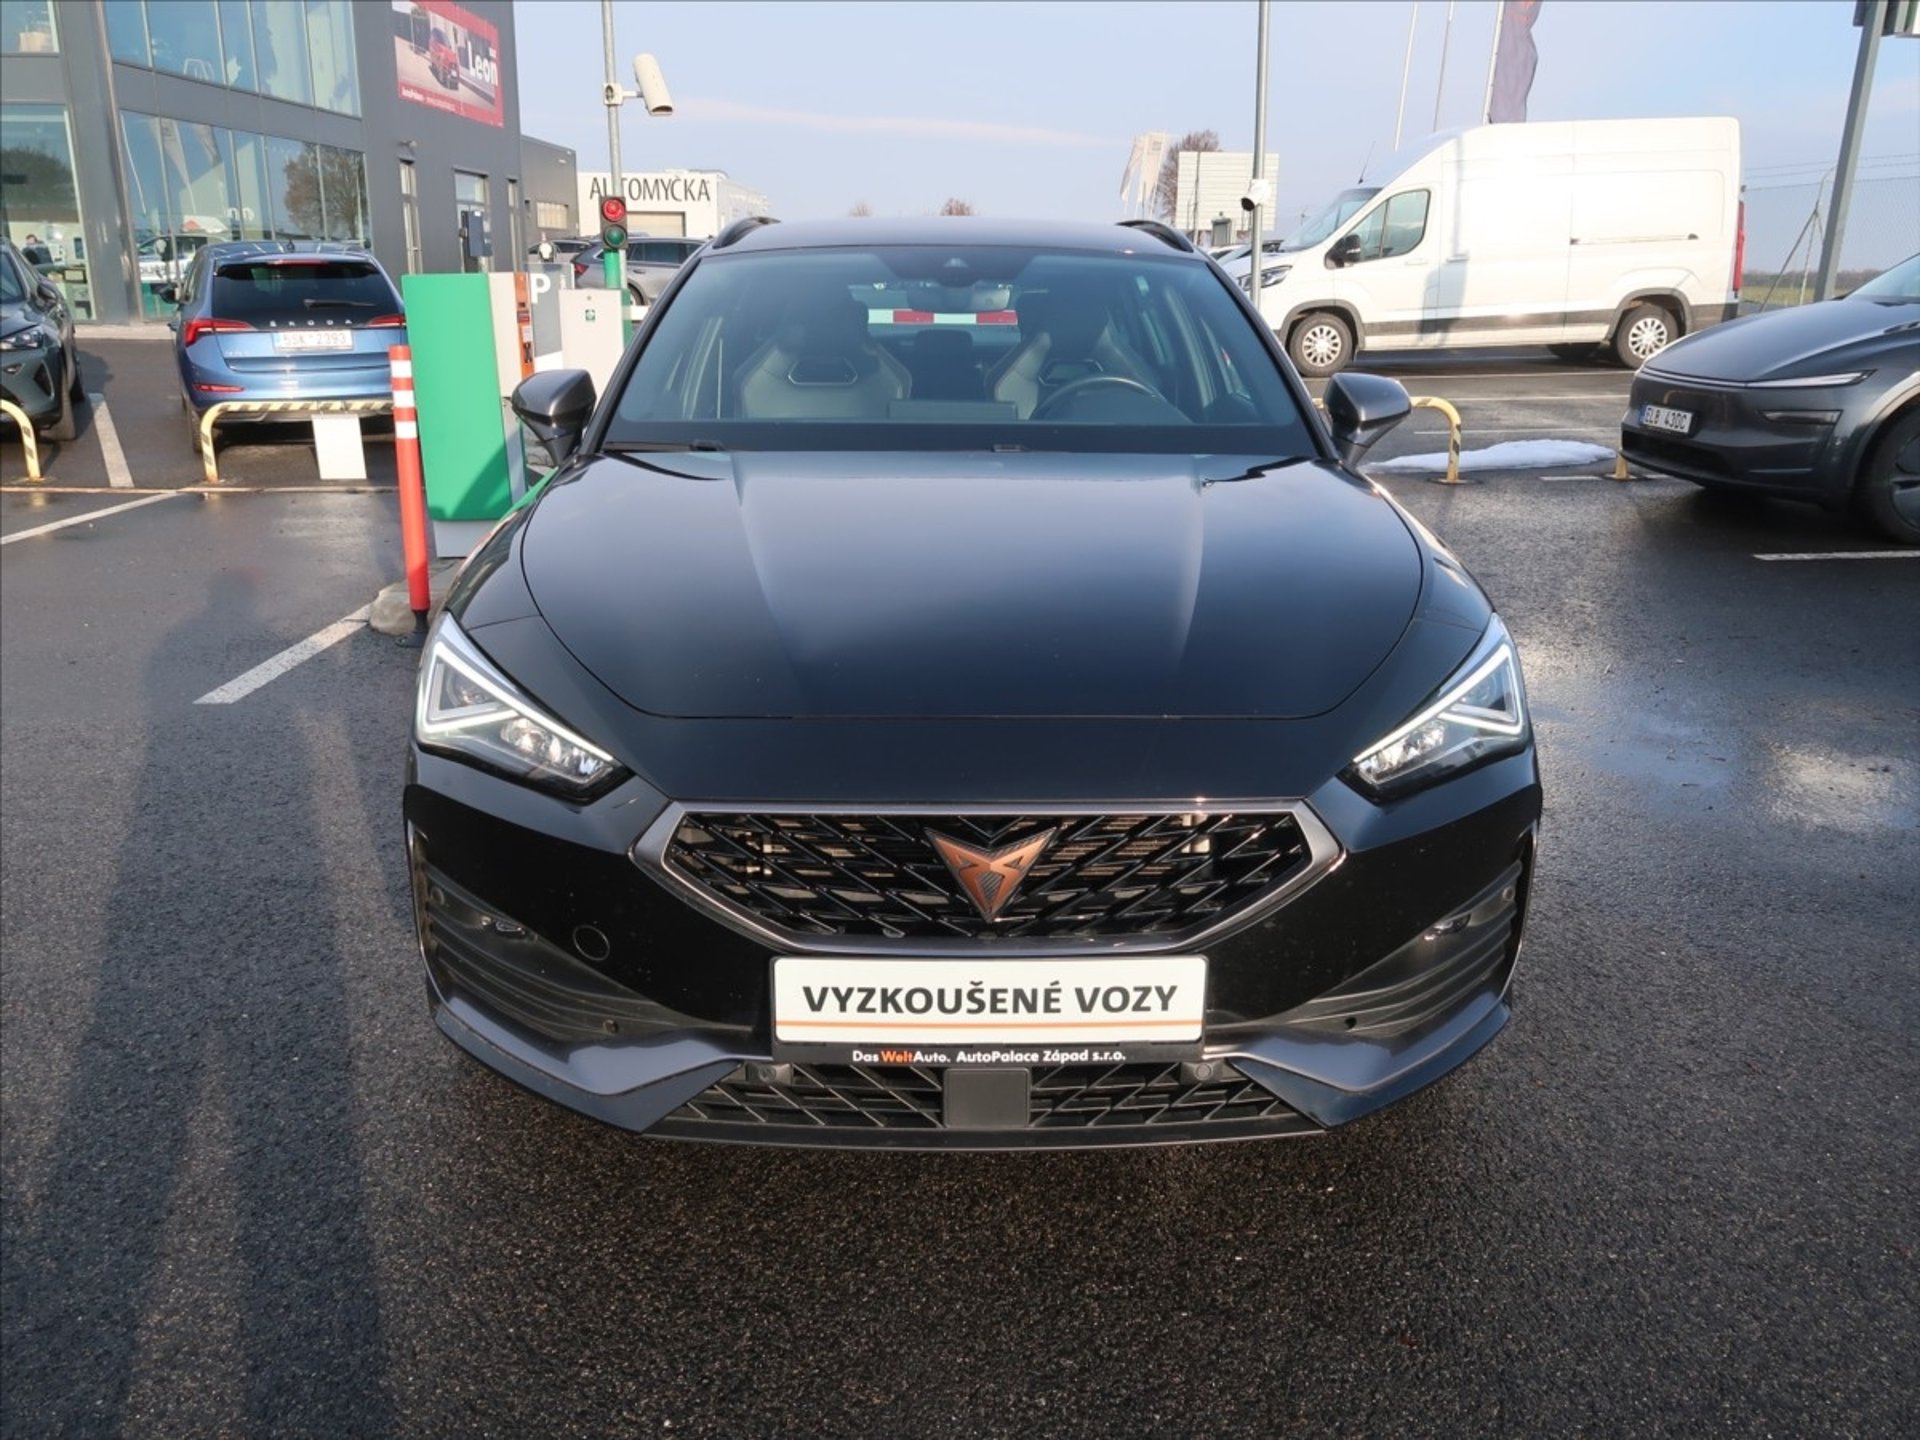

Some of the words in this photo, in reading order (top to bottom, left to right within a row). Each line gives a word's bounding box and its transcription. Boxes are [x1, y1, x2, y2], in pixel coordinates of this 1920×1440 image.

[531, 272, 552, 305] P
[802, 980, 1062, 1014] VYZKOUŠENÉ
[1075, 985, 1178, 1013] VOZY
[853, 1050, 879, 1062] Das
[956, 1049, 1039, 1063] AutoPalace
[1042, 1049, 1089, 1064] Západ
[1092, 1051, 1126, 1061] s.r.o.
